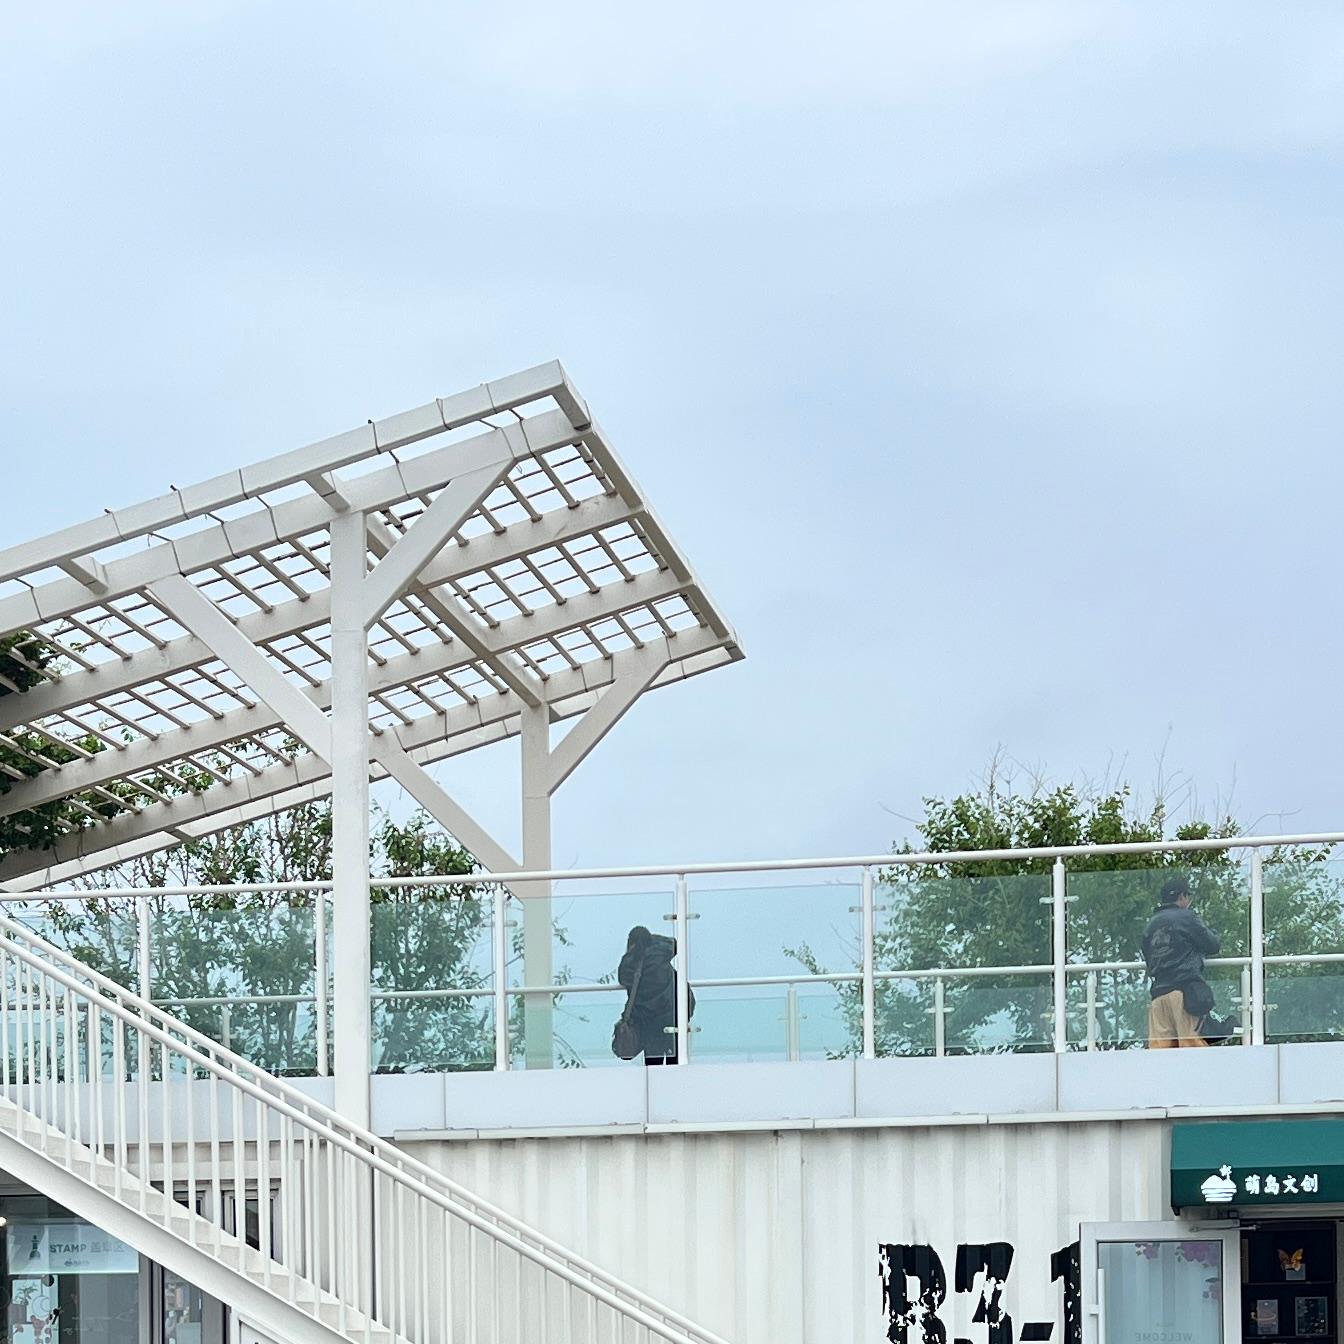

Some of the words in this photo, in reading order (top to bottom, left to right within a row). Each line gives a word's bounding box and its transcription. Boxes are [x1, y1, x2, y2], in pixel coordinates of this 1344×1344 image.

[1244, 1174, 1319, 1195] 萌岛文创
[49, 1243, 87, 1254] STAMP
